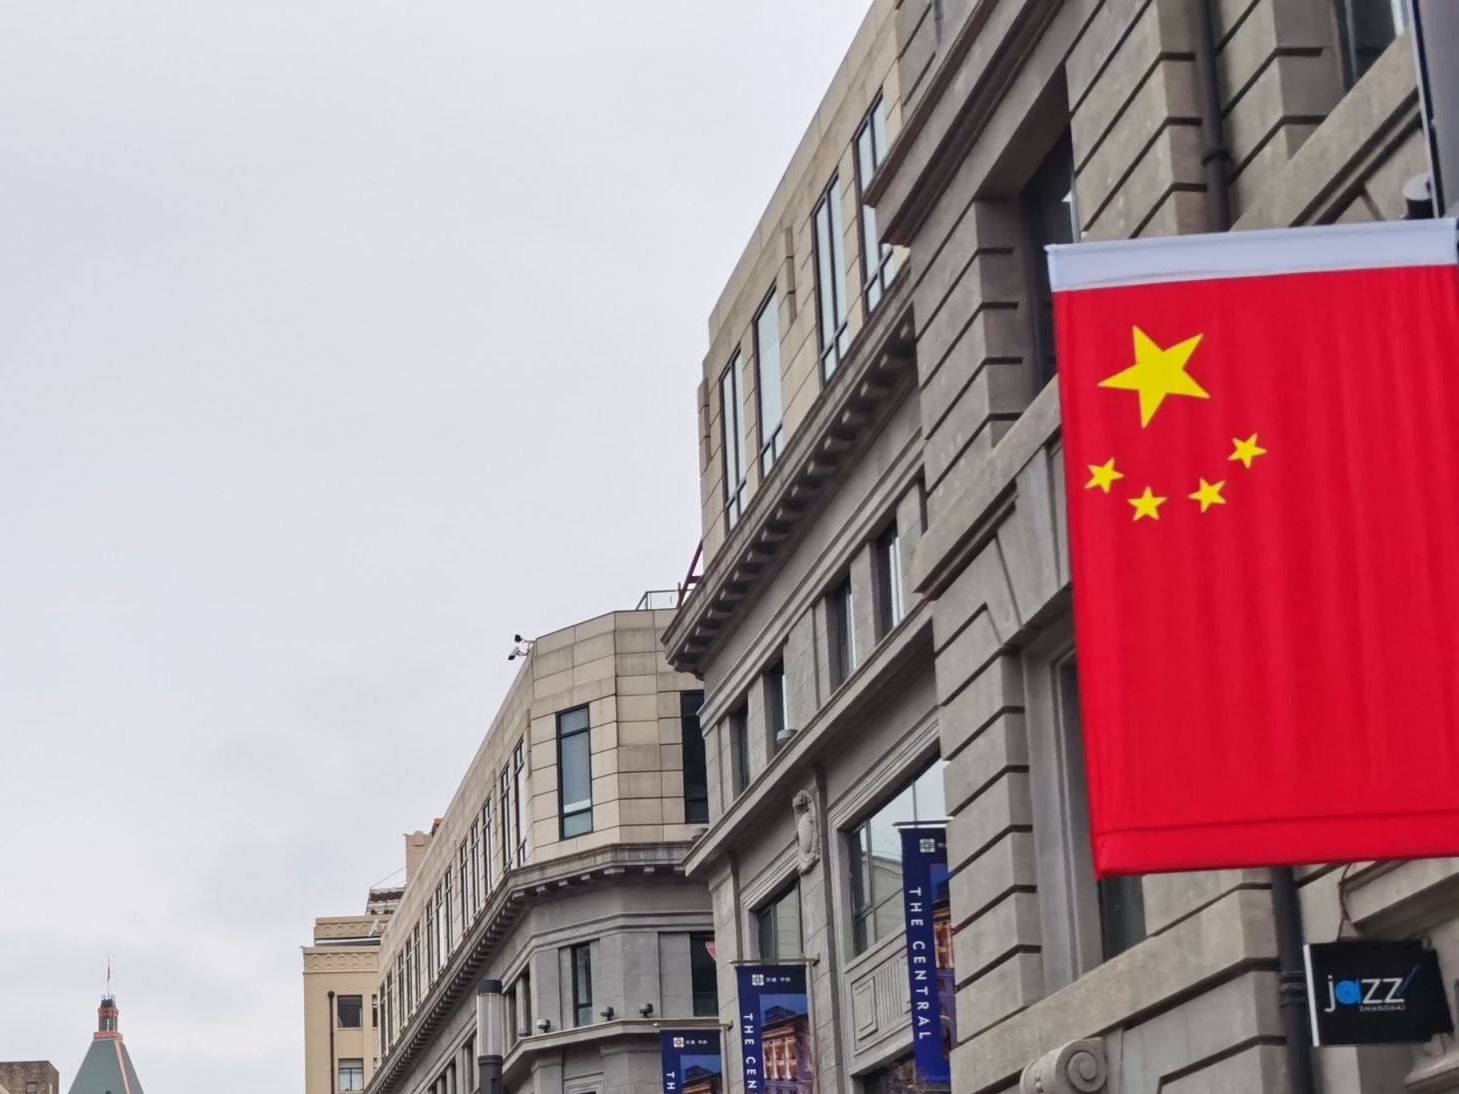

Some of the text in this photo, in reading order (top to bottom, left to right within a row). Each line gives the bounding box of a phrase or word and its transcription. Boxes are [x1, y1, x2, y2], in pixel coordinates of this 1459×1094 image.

[908, 886, 932, 1040] THE CENTRAL
[1324, 974, 1406, 1013] jazz
[743, 1012, 755, 1046] THE
